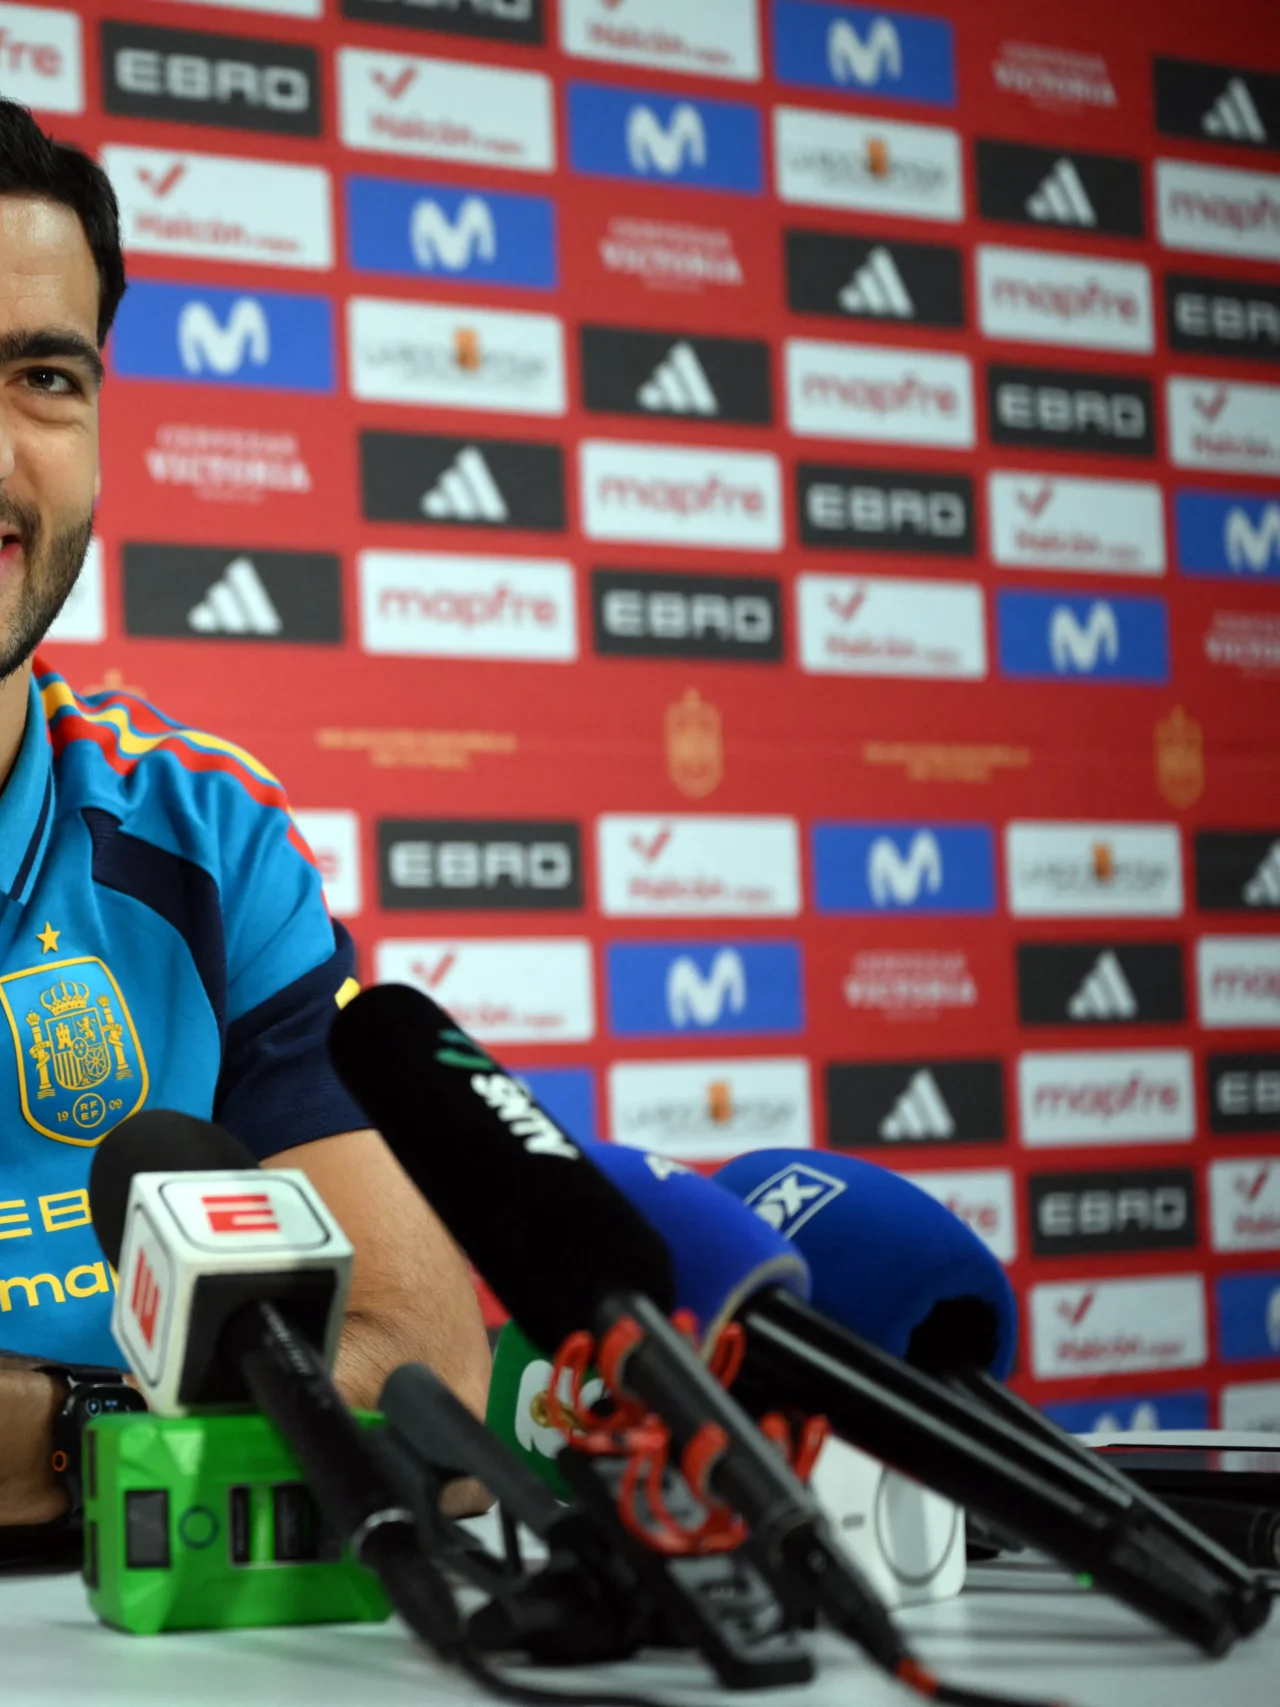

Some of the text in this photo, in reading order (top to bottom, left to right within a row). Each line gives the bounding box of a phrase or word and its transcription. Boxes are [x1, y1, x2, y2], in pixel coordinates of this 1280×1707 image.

[116, 46, 310, 111] EBRO
[390, 842, 570, 887] EBRO
[57, 1111, 69, 1122] 19
